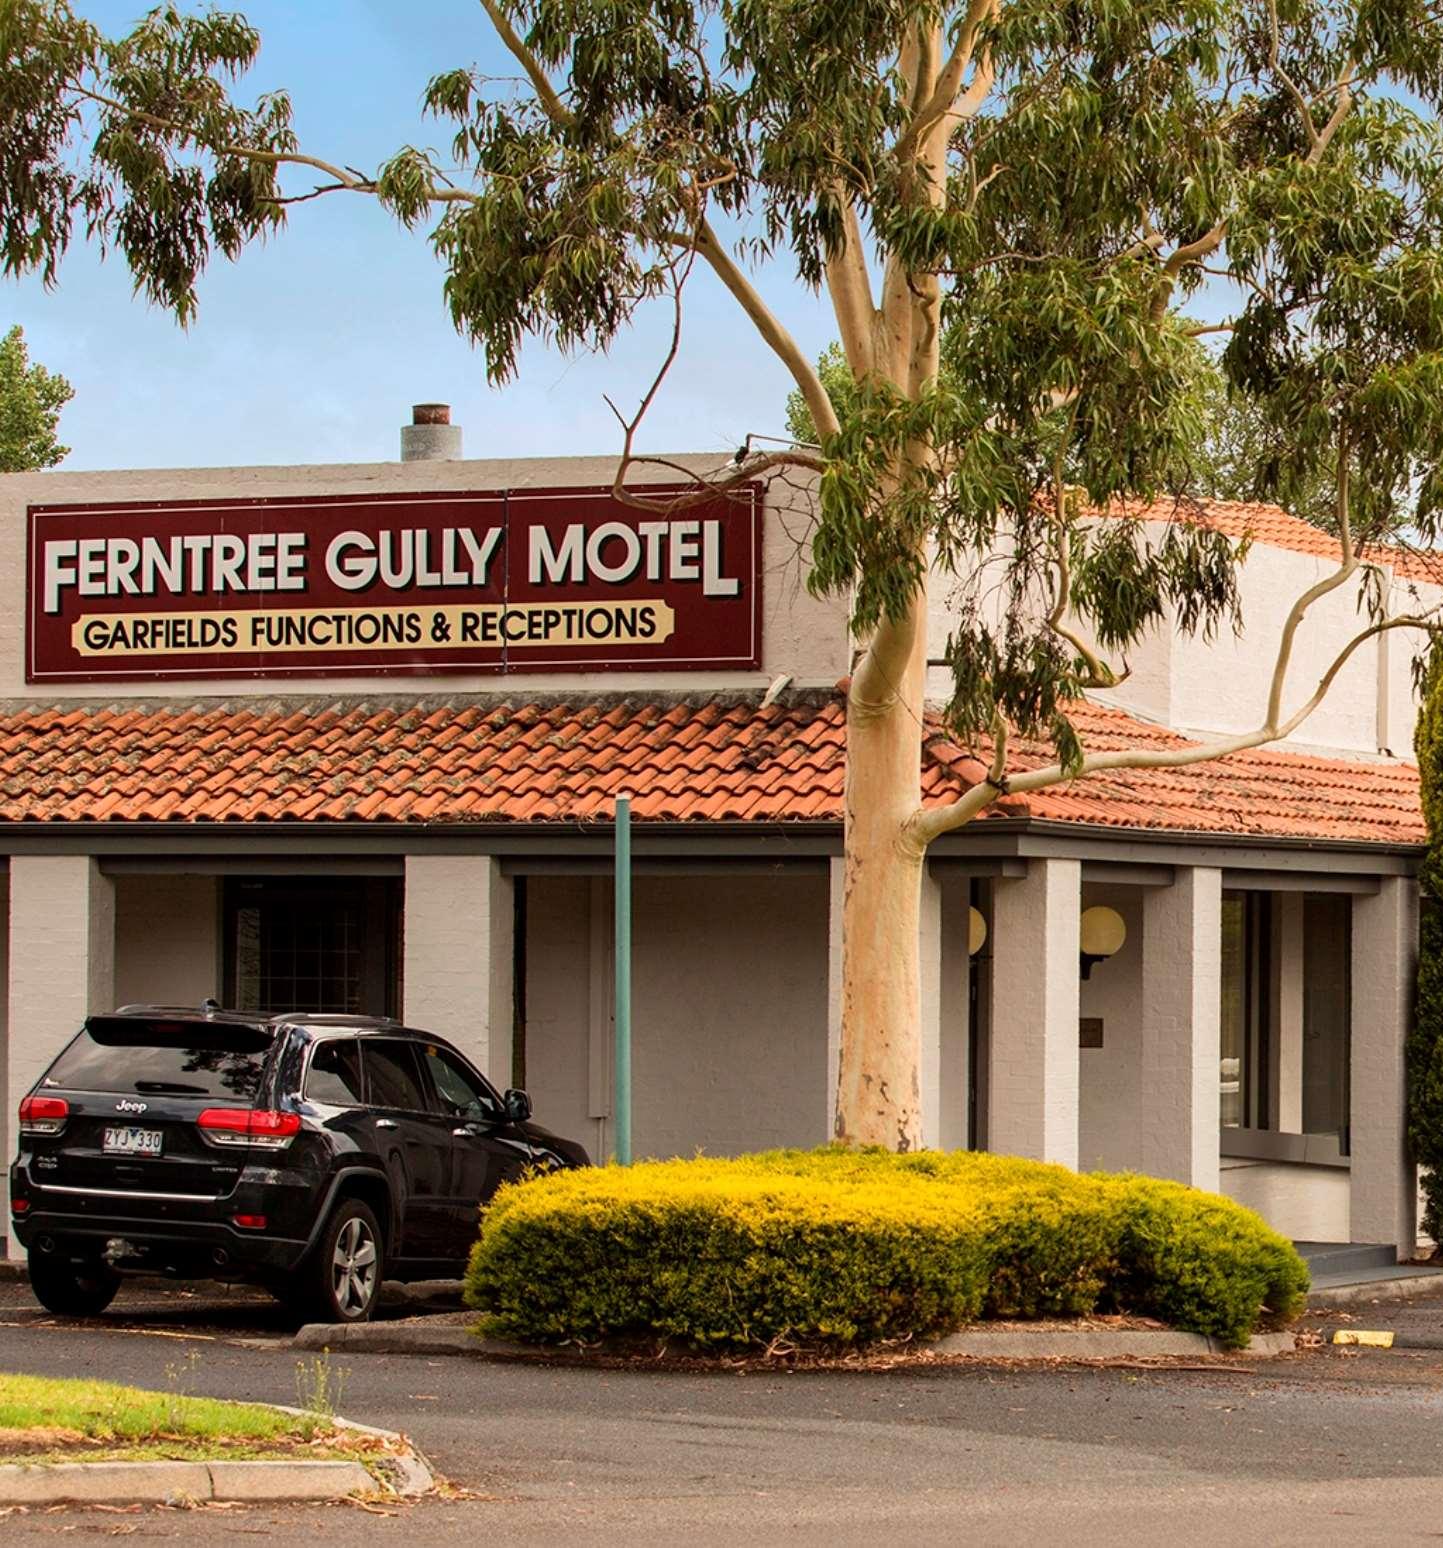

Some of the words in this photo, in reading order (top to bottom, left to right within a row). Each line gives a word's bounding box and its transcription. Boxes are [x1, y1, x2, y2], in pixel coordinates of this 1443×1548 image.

[44, 532, 306, 613] FERNTREE
[324, 526, 503, 591] GULLY
[528, 519, 740, 596] MOTEL
[83, 618, 239, 650] GARFIELDS
[251, 613, 421, 645] FUNCTIONS
[431, 613, 451, 641] &
[463, 607, 656, 640] RECEPTIONS
[115, 1099, 147, 1114] Jeep
